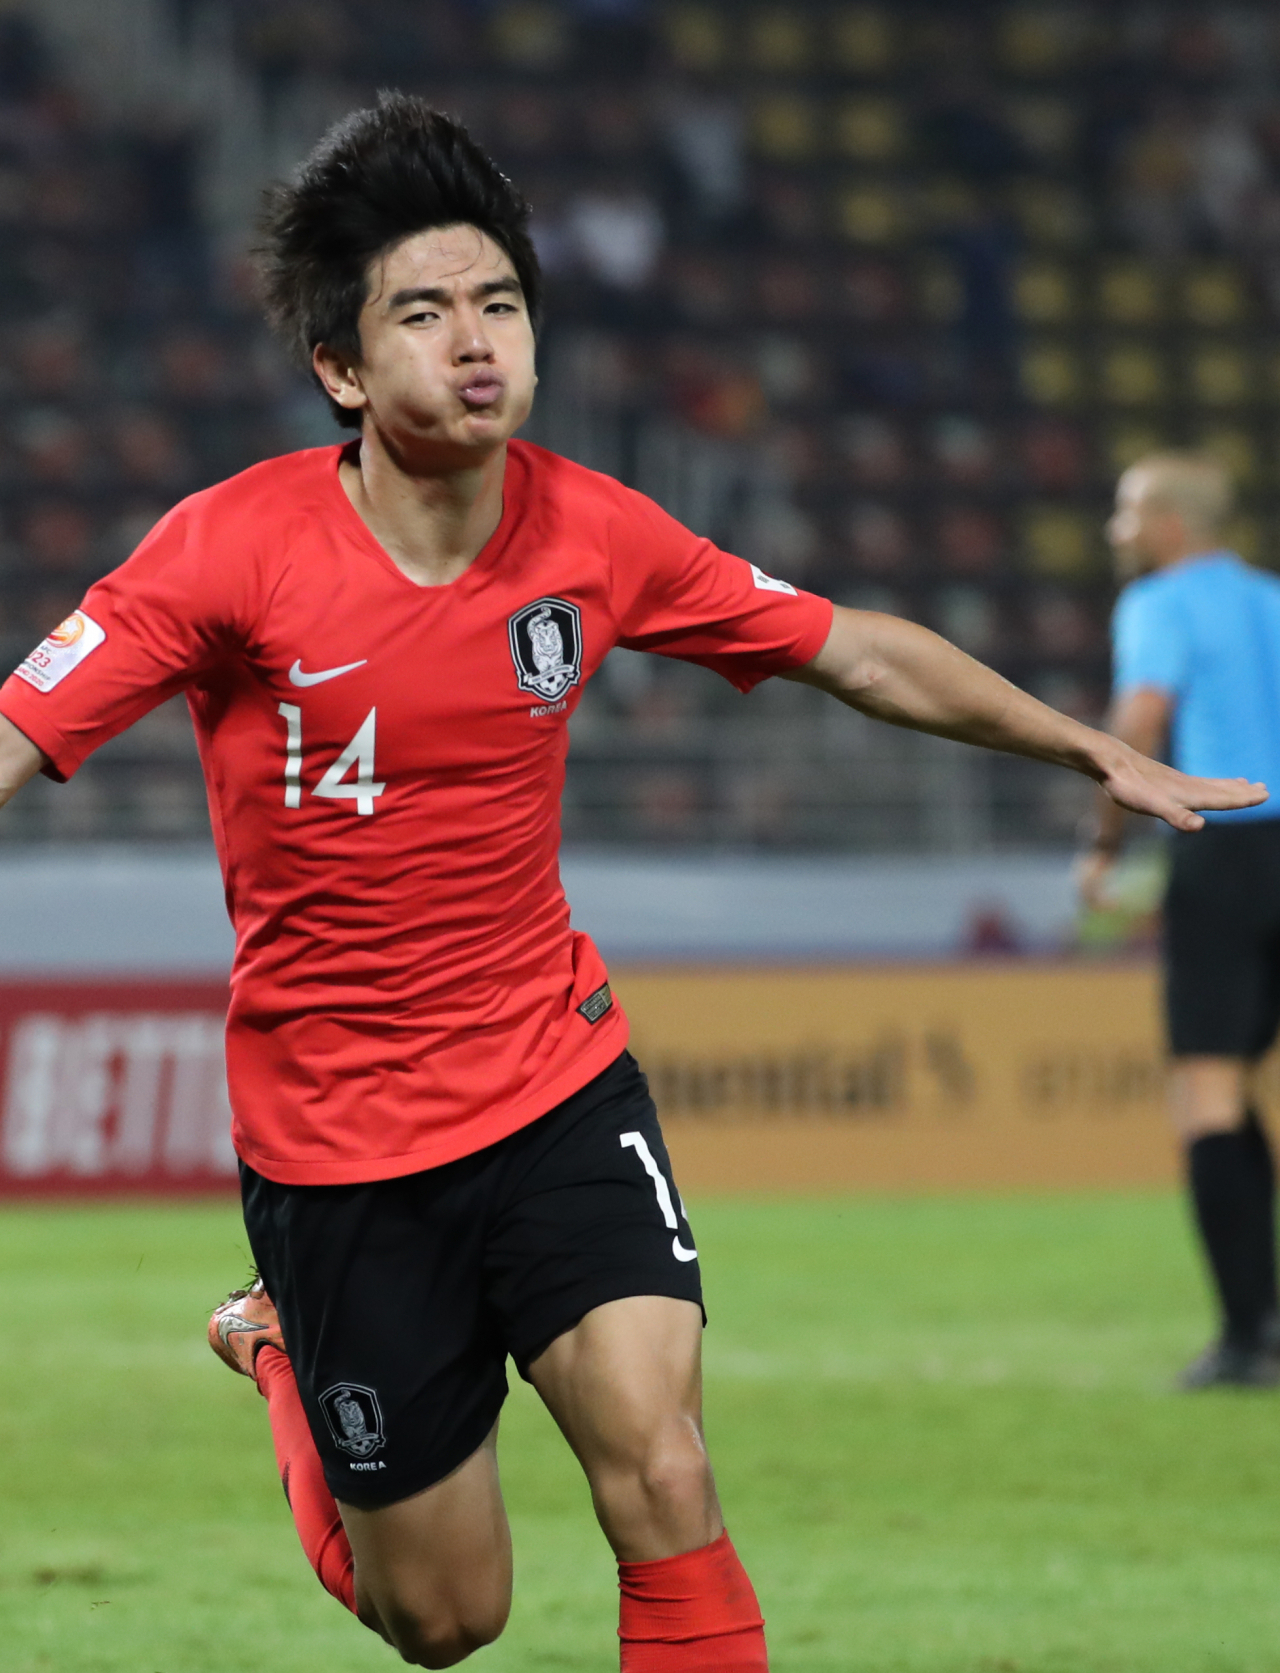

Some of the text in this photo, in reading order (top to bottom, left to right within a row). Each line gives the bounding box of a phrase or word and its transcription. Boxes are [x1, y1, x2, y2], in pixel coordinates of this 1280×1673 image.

[529, 700, 568, 718] KOREA
[277, 701, 387, 816] 14
[619, 1131, 689, 1230] 1
[349, 1460, 387, 1472] KOREA
